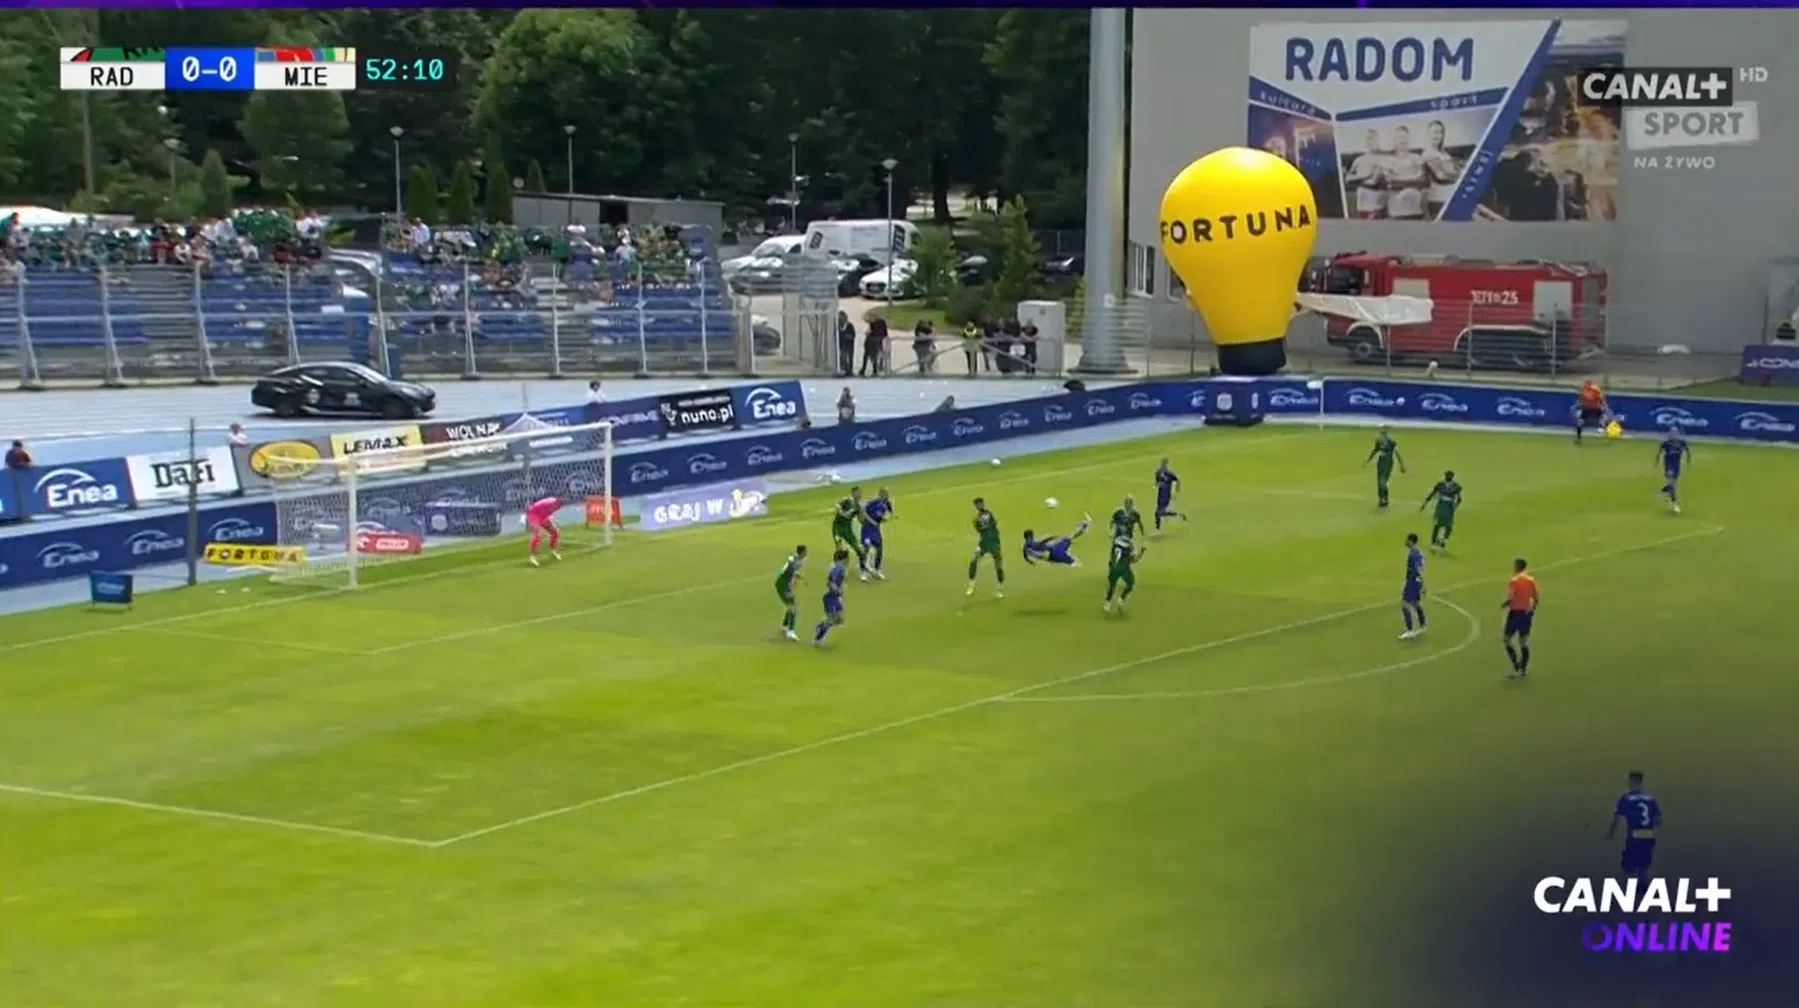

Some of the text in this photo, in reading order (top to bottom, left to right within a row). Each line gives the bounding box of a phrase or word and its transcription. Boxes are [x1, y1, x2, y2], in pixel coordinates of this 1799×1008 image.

[1286, 37, 1474, 82] RADOM
[1159, 203, 1311, 245] FORTUNA
[681, 404, 734, 423] nuno.pl
[752, 399, 797, 419] Enea
[47, 484, 119, 508] Enea
[653, 501, 701, 524] GRAJ
[706, 498, 724, 515] W
[1637, 801, 1650, 826] 3
